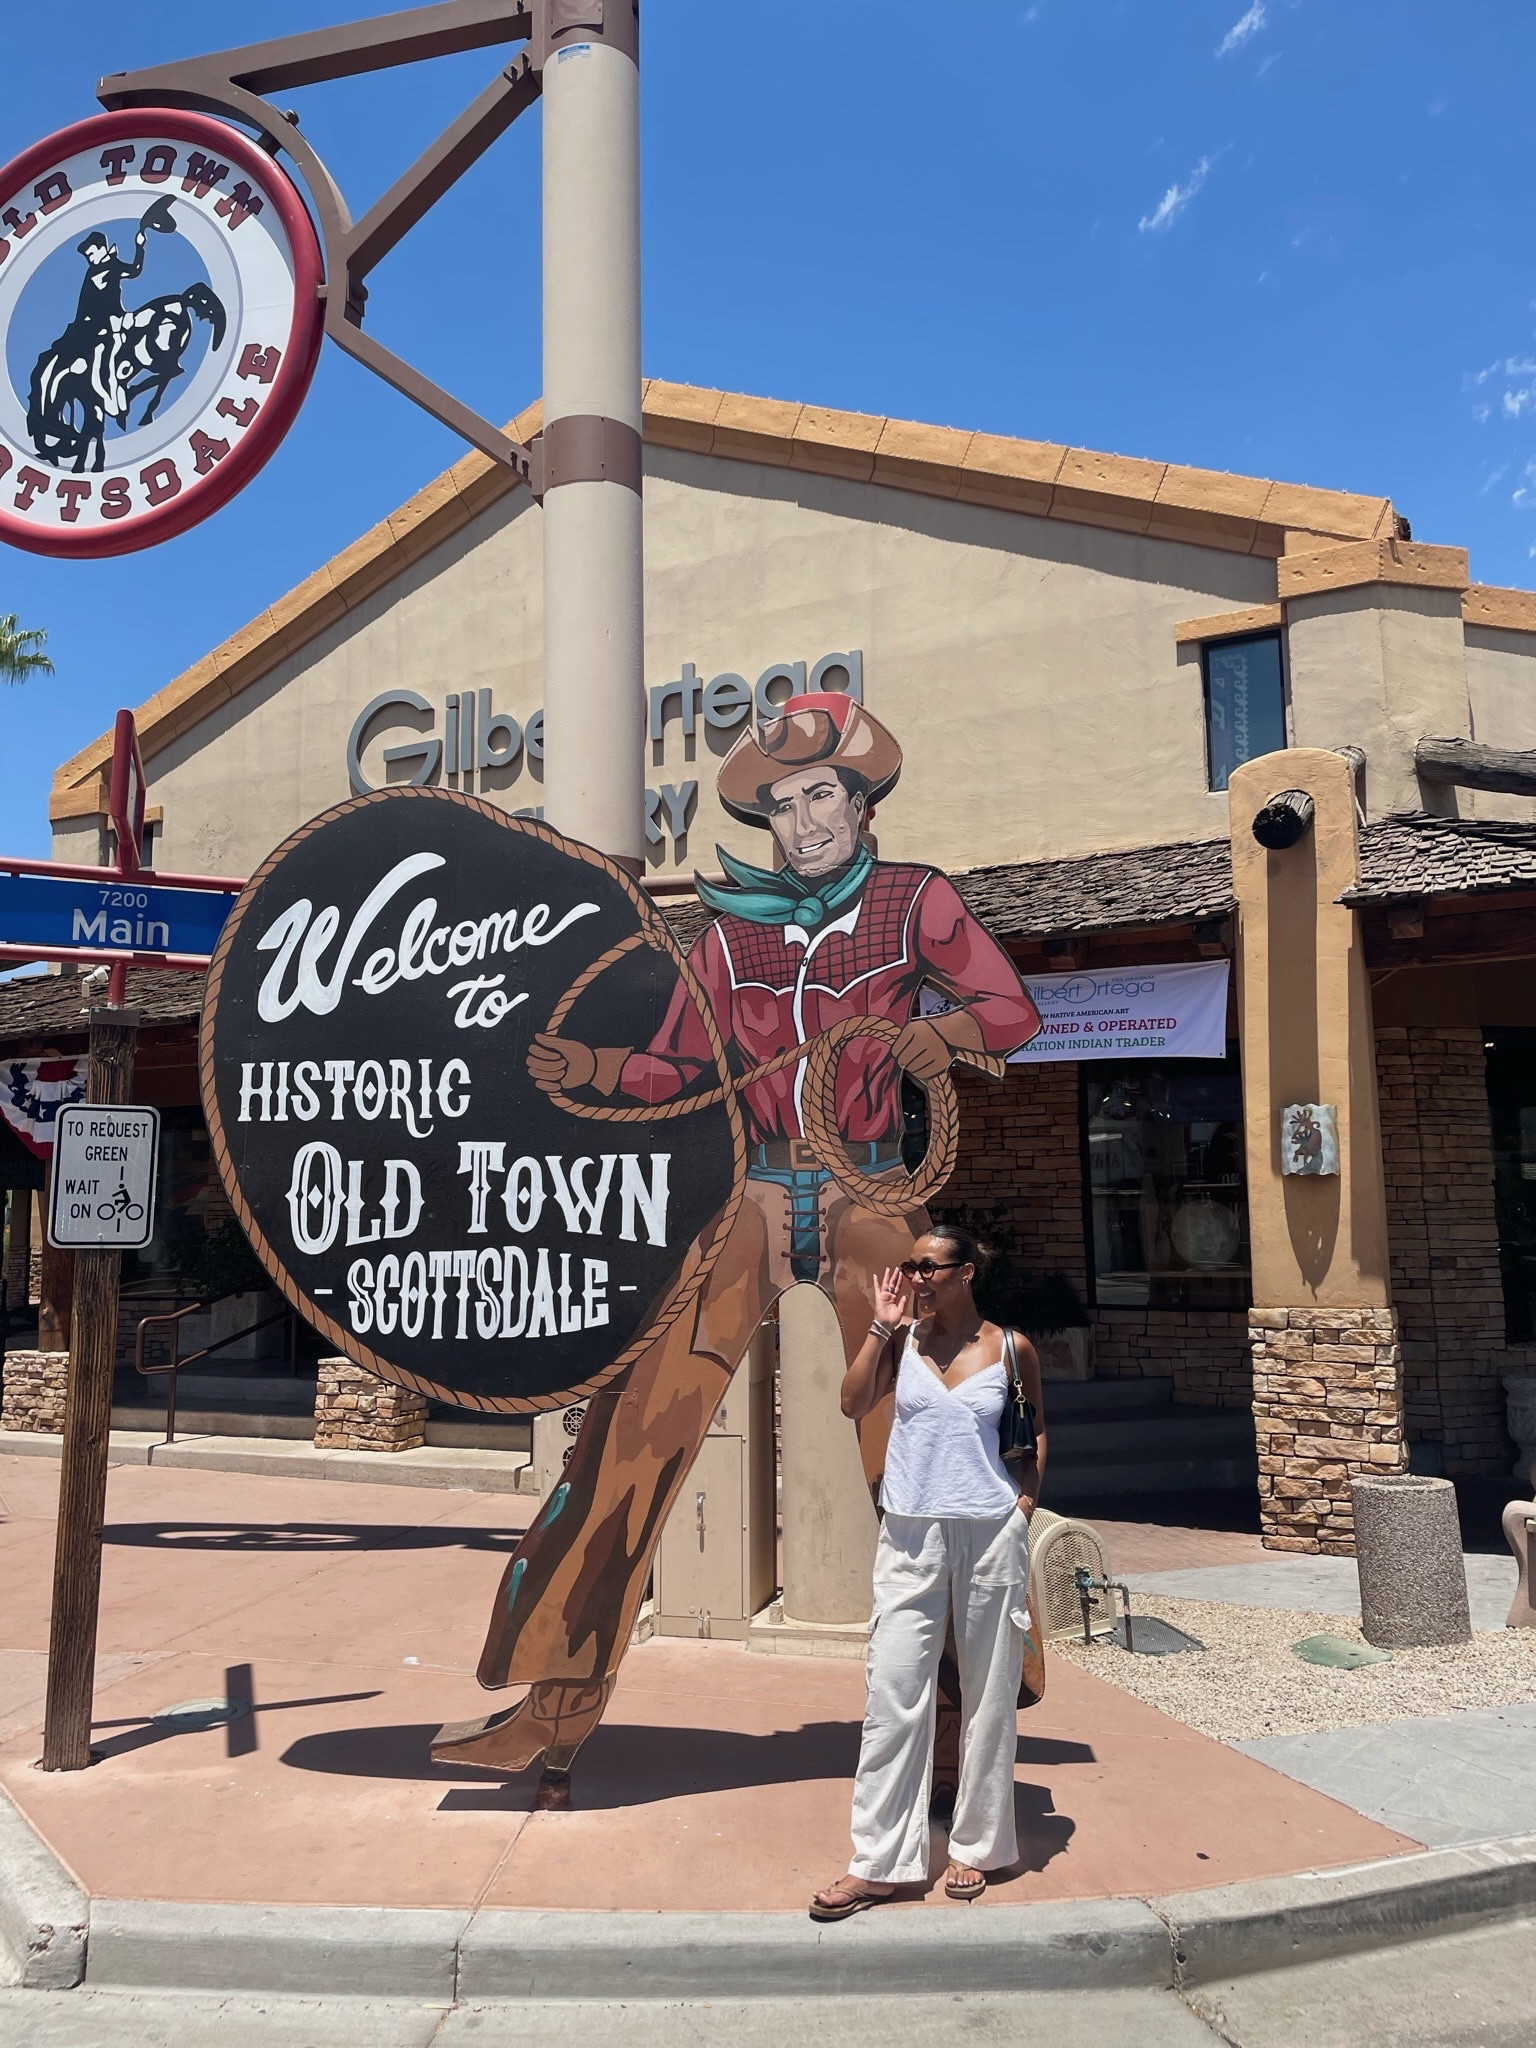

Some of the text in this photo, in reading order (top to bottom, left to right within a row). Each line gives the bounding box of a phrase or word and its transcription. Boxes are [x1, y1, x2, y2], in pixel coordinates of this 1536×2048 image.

[0, 144, 264, 265] LD TOWN
[0, 342, 283, 523] TTSDALE
[645, 649, 863, 741] rtega
[99, 890, 148, 908] 7200
[71, 908, 169, 948] Main
[256, 852, 601, 1023] Welcome
[1026, 984, 1082, 1001] ilbert
[1050, 1011, 1075, 1019] NATIVE
[1076, 1009, 1114, 1017] AMERICAN
[1115, 1007, 1130, 1015] ART
[1083, 1021, 1094, 1033] &
[1098, 1018, 1177, 1032] OPERATED
[1068, 1038, 1113, 1049] INDIAN
[1116, 1036, 1166, 1047] TRADER
[237, 1058, 471, 1138] HISTORIC
[67, 1120, 149, 1140] TO REQUEST
[85, 1145, 129, 1162] GREEN
[65, 1178, 100, 1196] WAIT
[285, 1140, 425, 1255] OLD
[70, 1202, 92, 1219] ON
[347, 1245, 610, 1340] SCOTTSDALE
